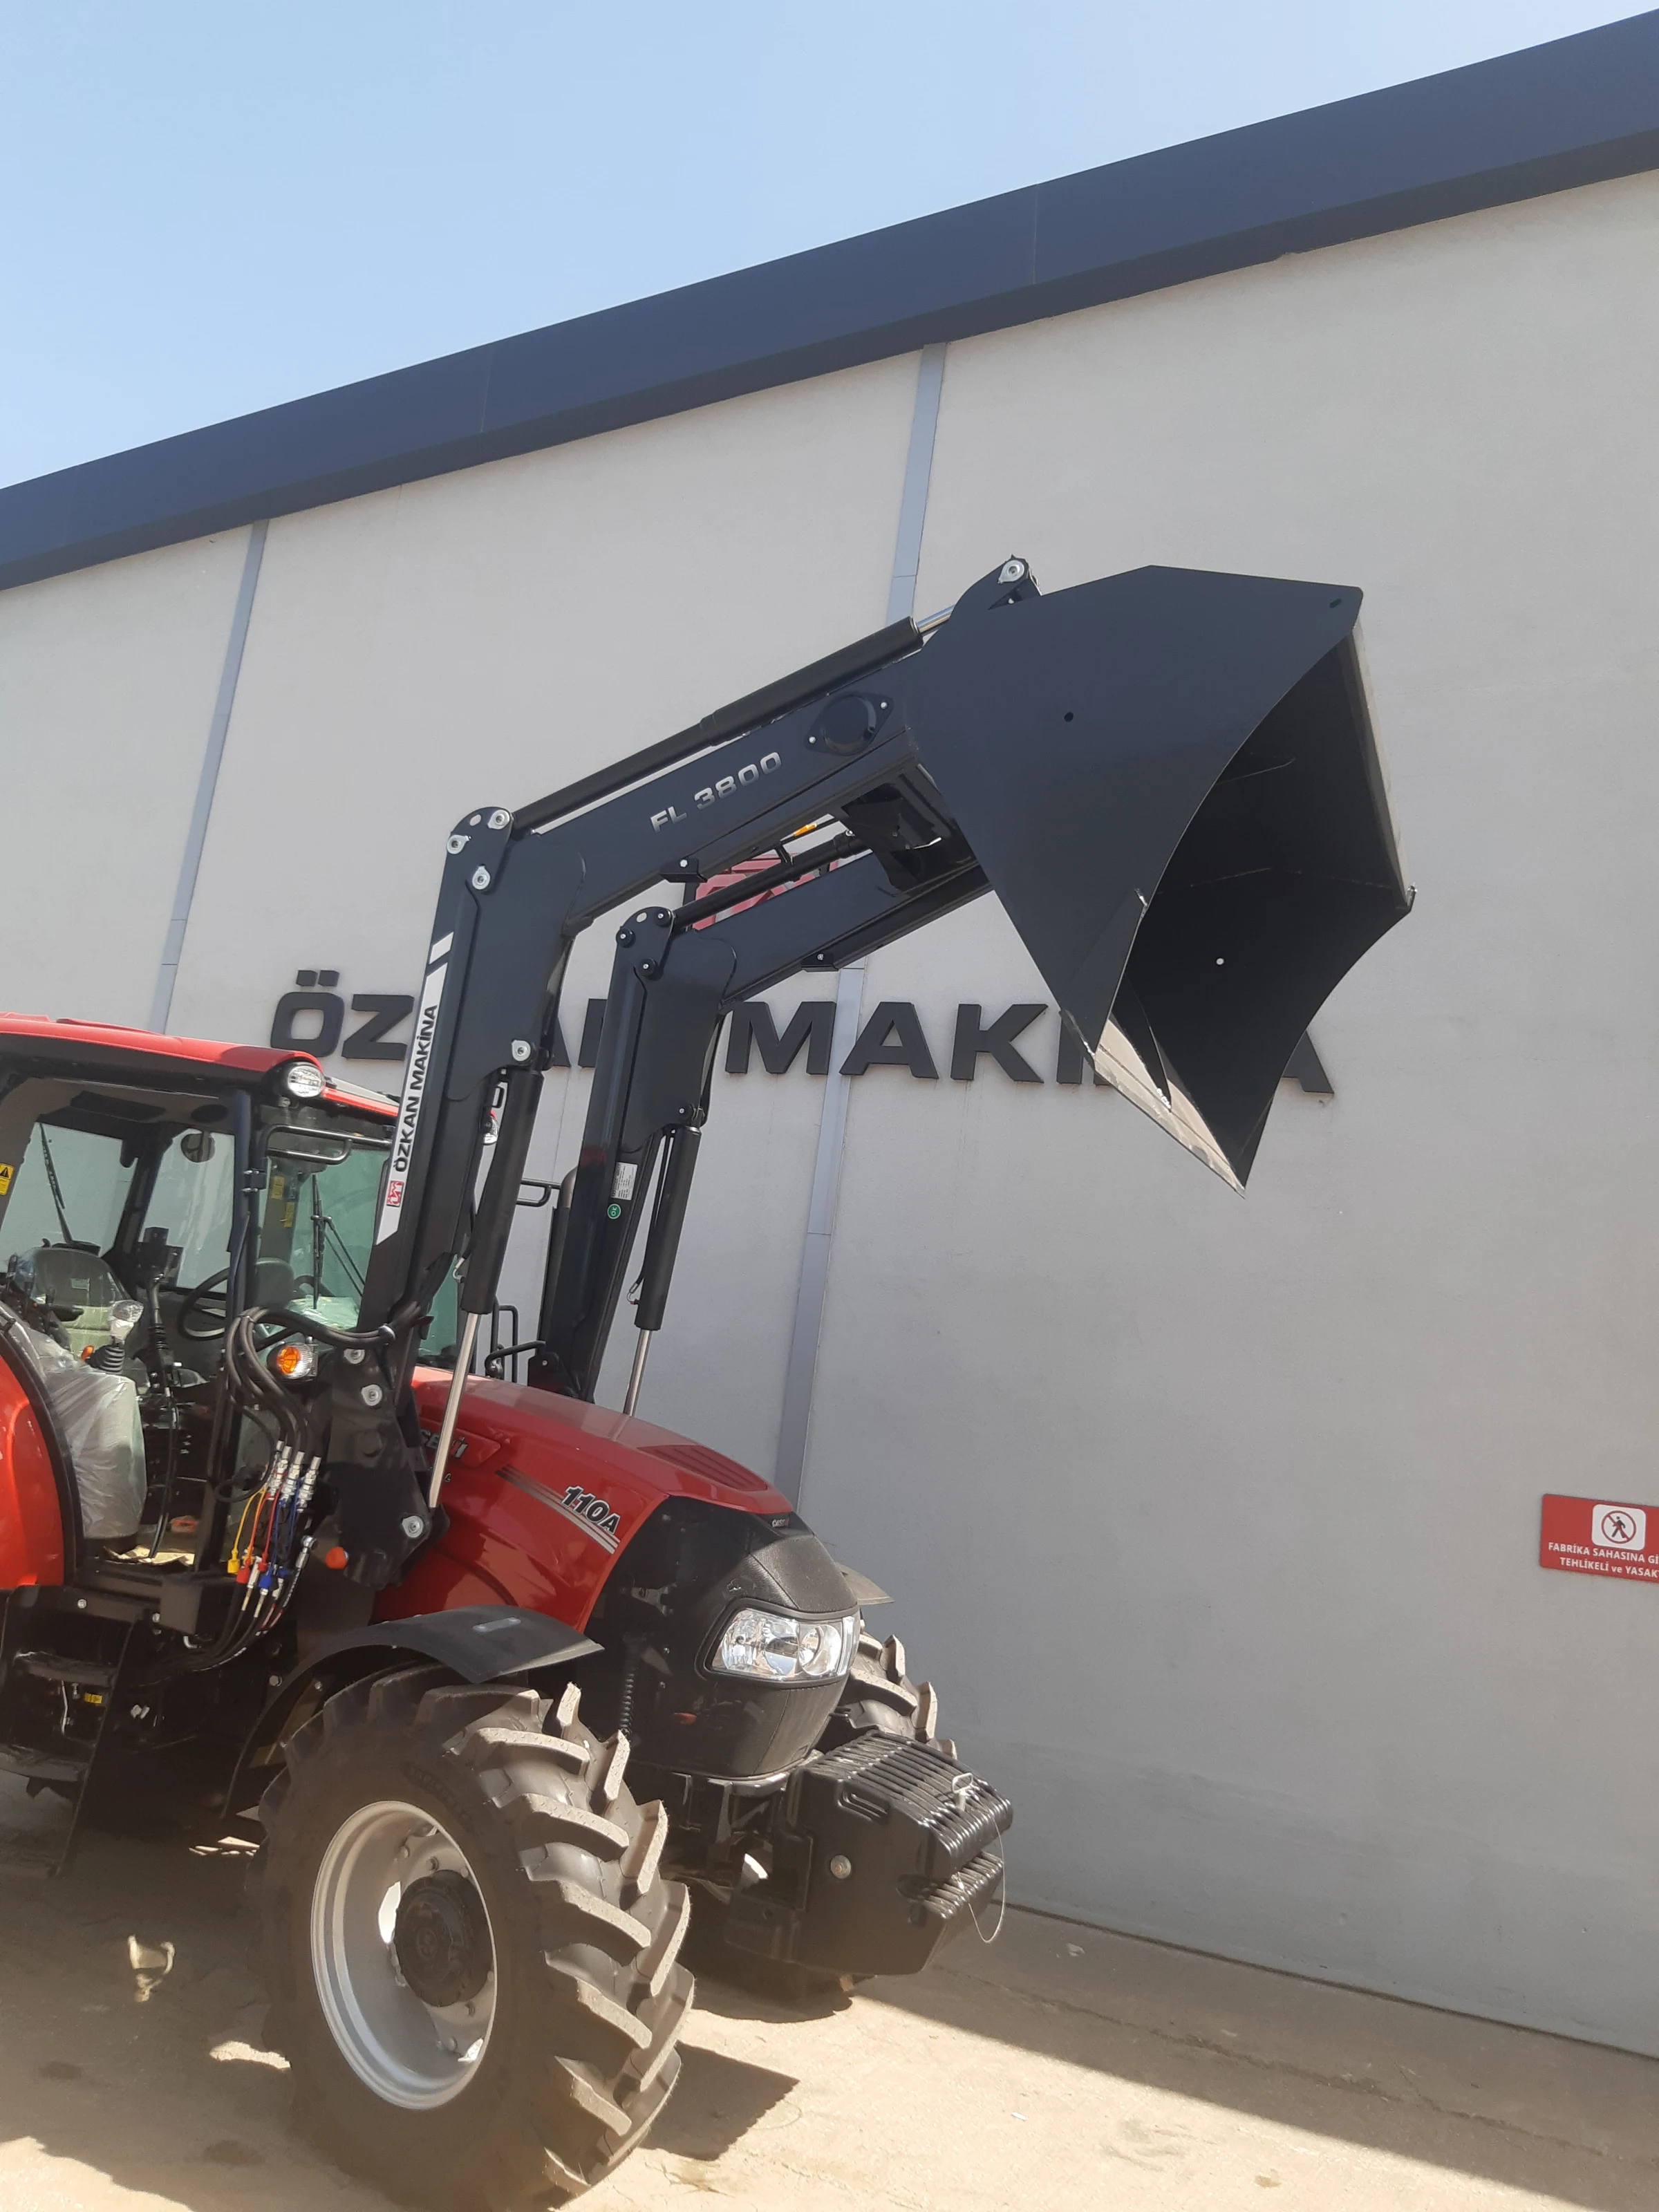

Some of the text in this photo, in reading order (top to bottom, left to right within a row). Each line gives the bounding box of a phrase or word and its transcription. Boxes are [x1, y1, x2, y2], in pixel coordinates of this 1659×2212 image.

[650, 751, 782, 833] FL 3800
[724, 1000, 1335, 1094] MAK
[393, 1096, 420, 1172] ÖZKAN
[410, 1005, 438, 1090] MAKİNA
[611, 1206, 618, 1217] OK
[561, 1485, 621, 1535] 110A
[1548, 1541, 1590, 1555] FABRİKA
[1593, 1548, 1645, 1563] SAHASINA
[1559, 1557, 1659, 1578] TEHLİKELİ ve YASAK
